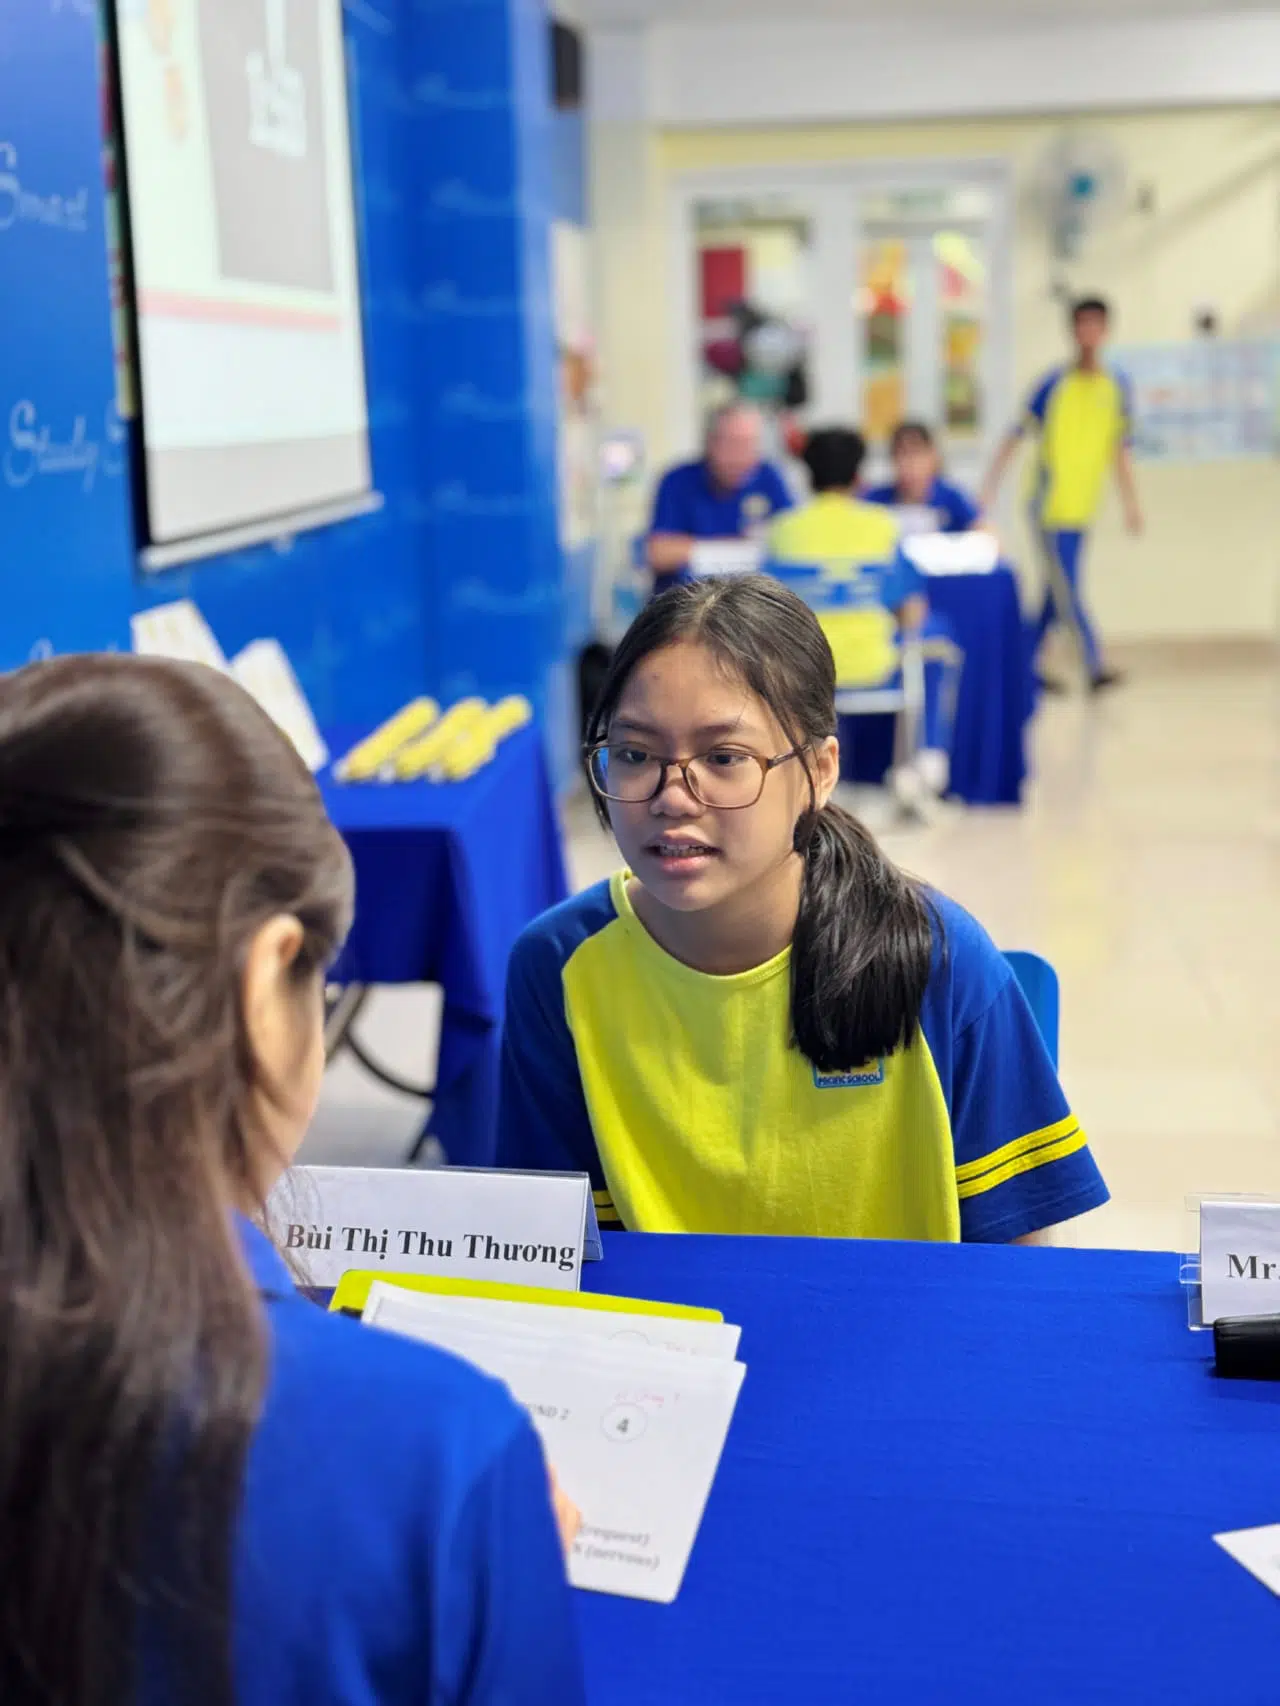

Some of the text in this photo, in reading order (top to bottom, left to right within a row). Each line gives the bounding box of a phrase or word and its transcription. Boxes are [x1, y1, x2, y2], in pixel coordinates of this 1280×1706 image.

[286, 1224, 576, 1271] Bùi Thị Thu Thương
[616, 1417, 630, 1433] 4
